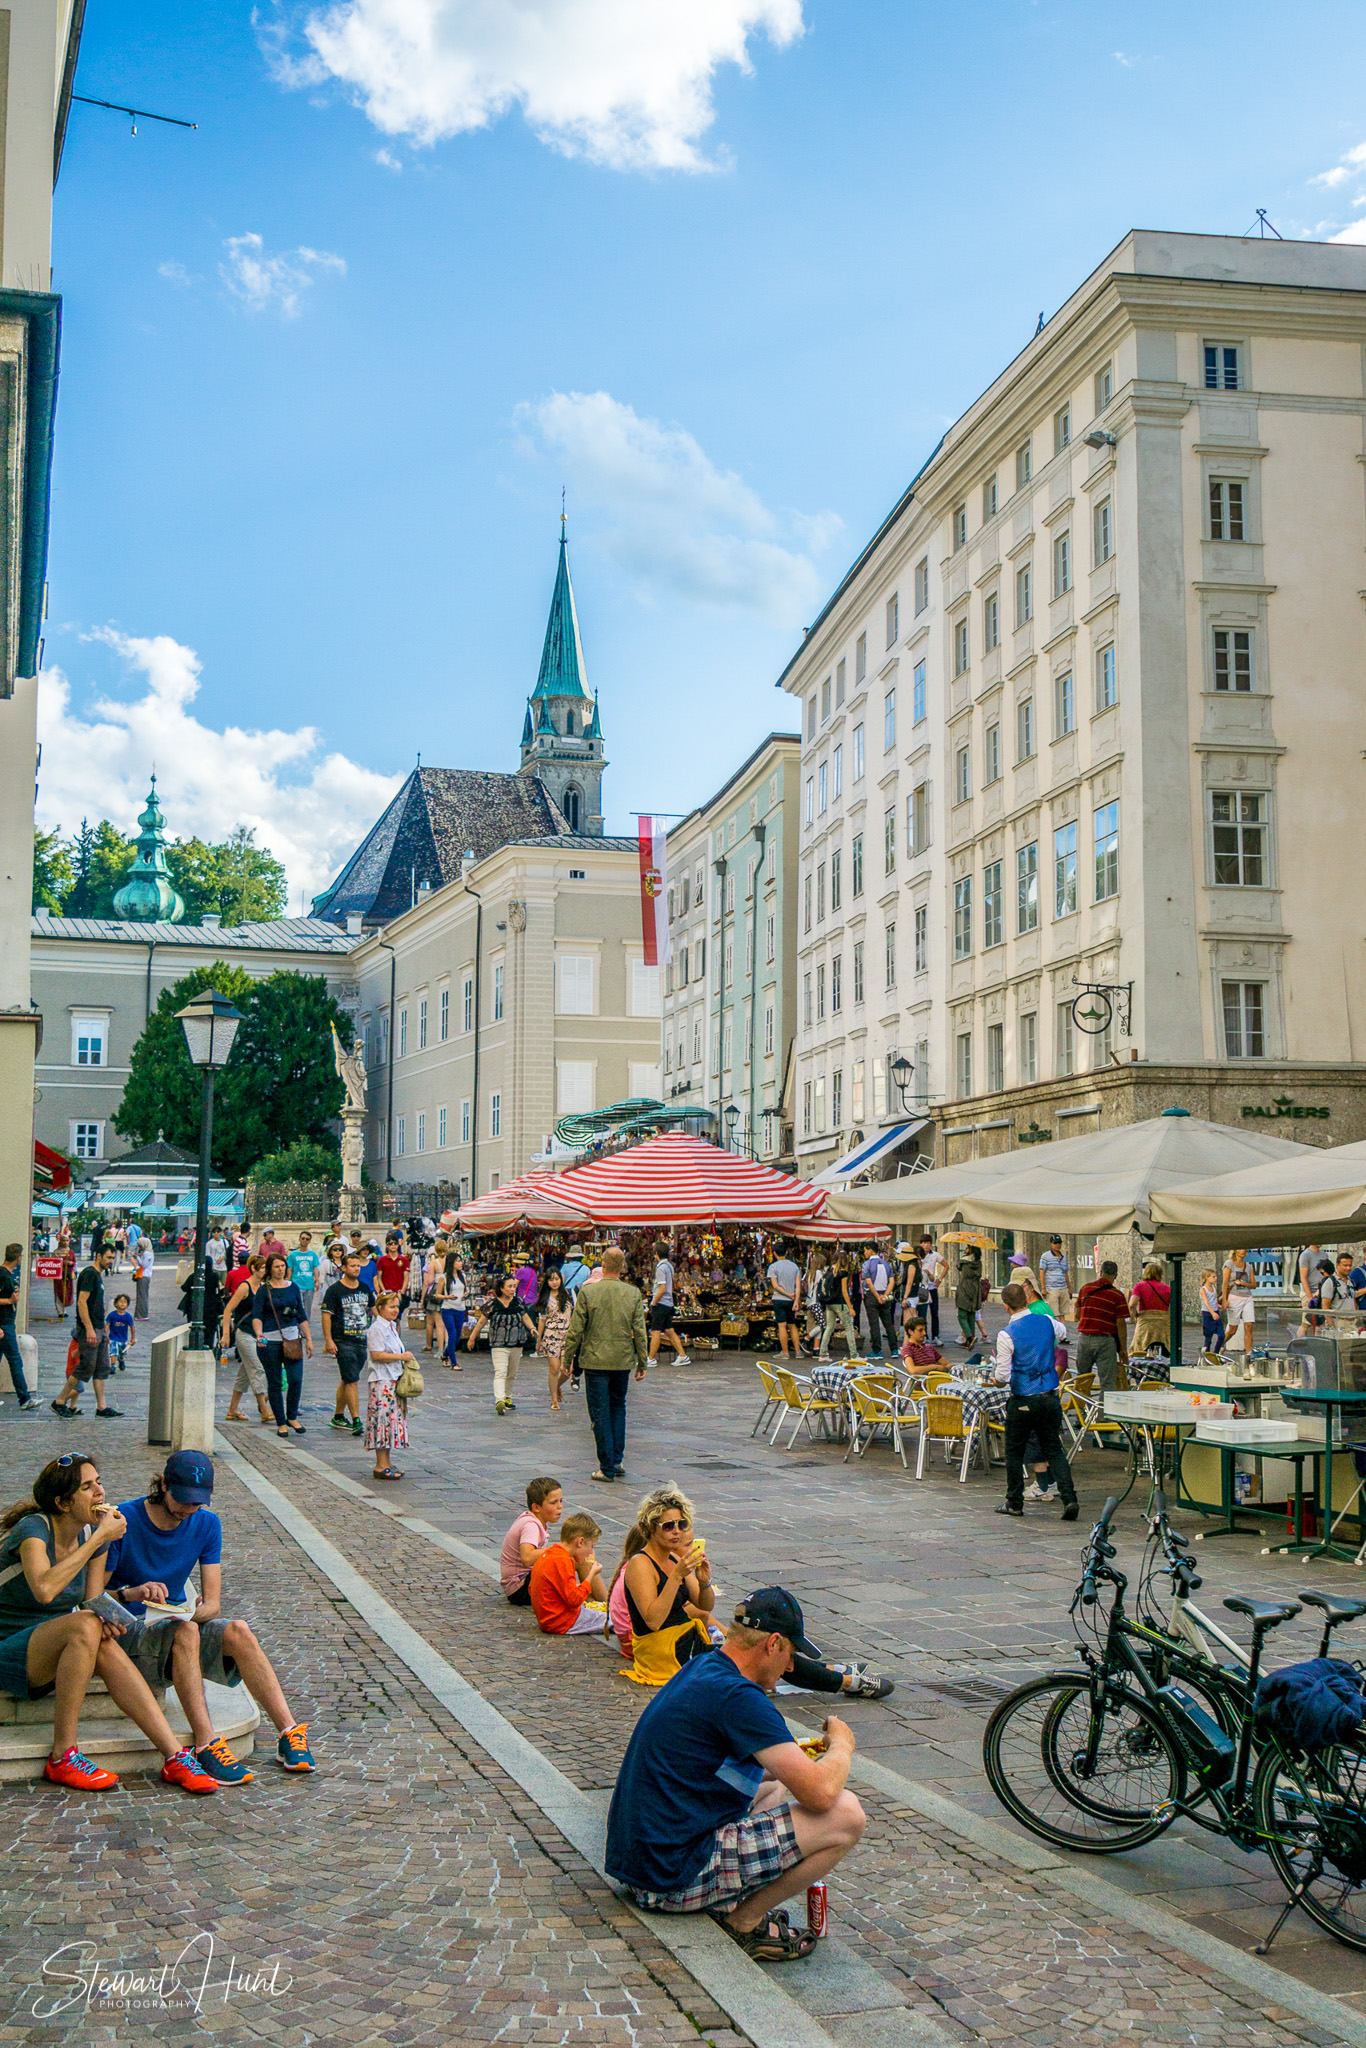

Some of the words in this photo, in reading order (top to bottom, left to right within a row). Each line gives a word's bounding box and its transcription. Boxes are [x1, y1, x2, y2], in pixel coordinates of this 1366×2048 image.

[1241, 1105, 1331, 1119] PALMERS
[37, 1260, 62, 1268] Geöffnet
[1077, 1254, 1094, 1269] SALE
[41, 1267, 57, 1276] Open
